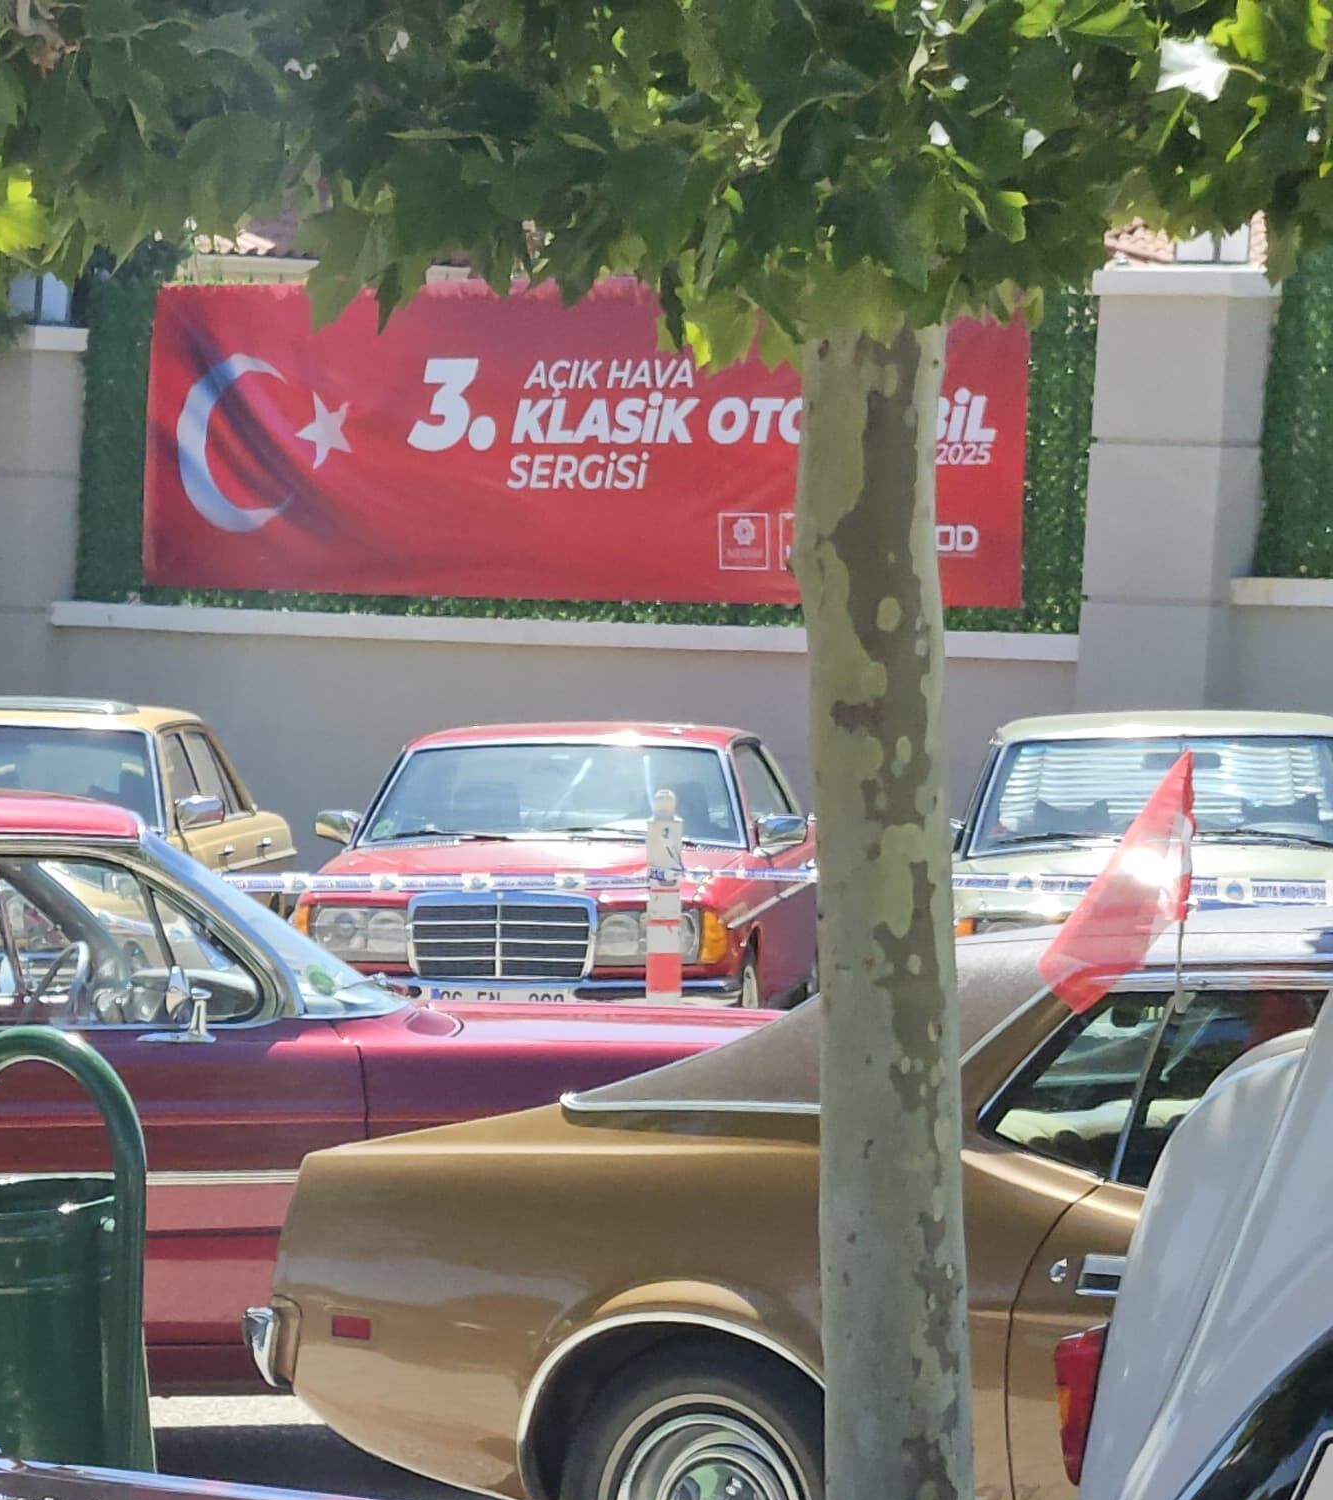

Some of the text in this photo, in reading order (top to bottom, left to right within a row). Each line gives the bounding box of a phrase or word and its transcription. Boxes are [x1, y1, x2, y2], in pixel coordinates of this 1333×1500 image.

[407, 358, 496, 451] 3.
[524, 359, 694, 397] AÇIK HAVA
